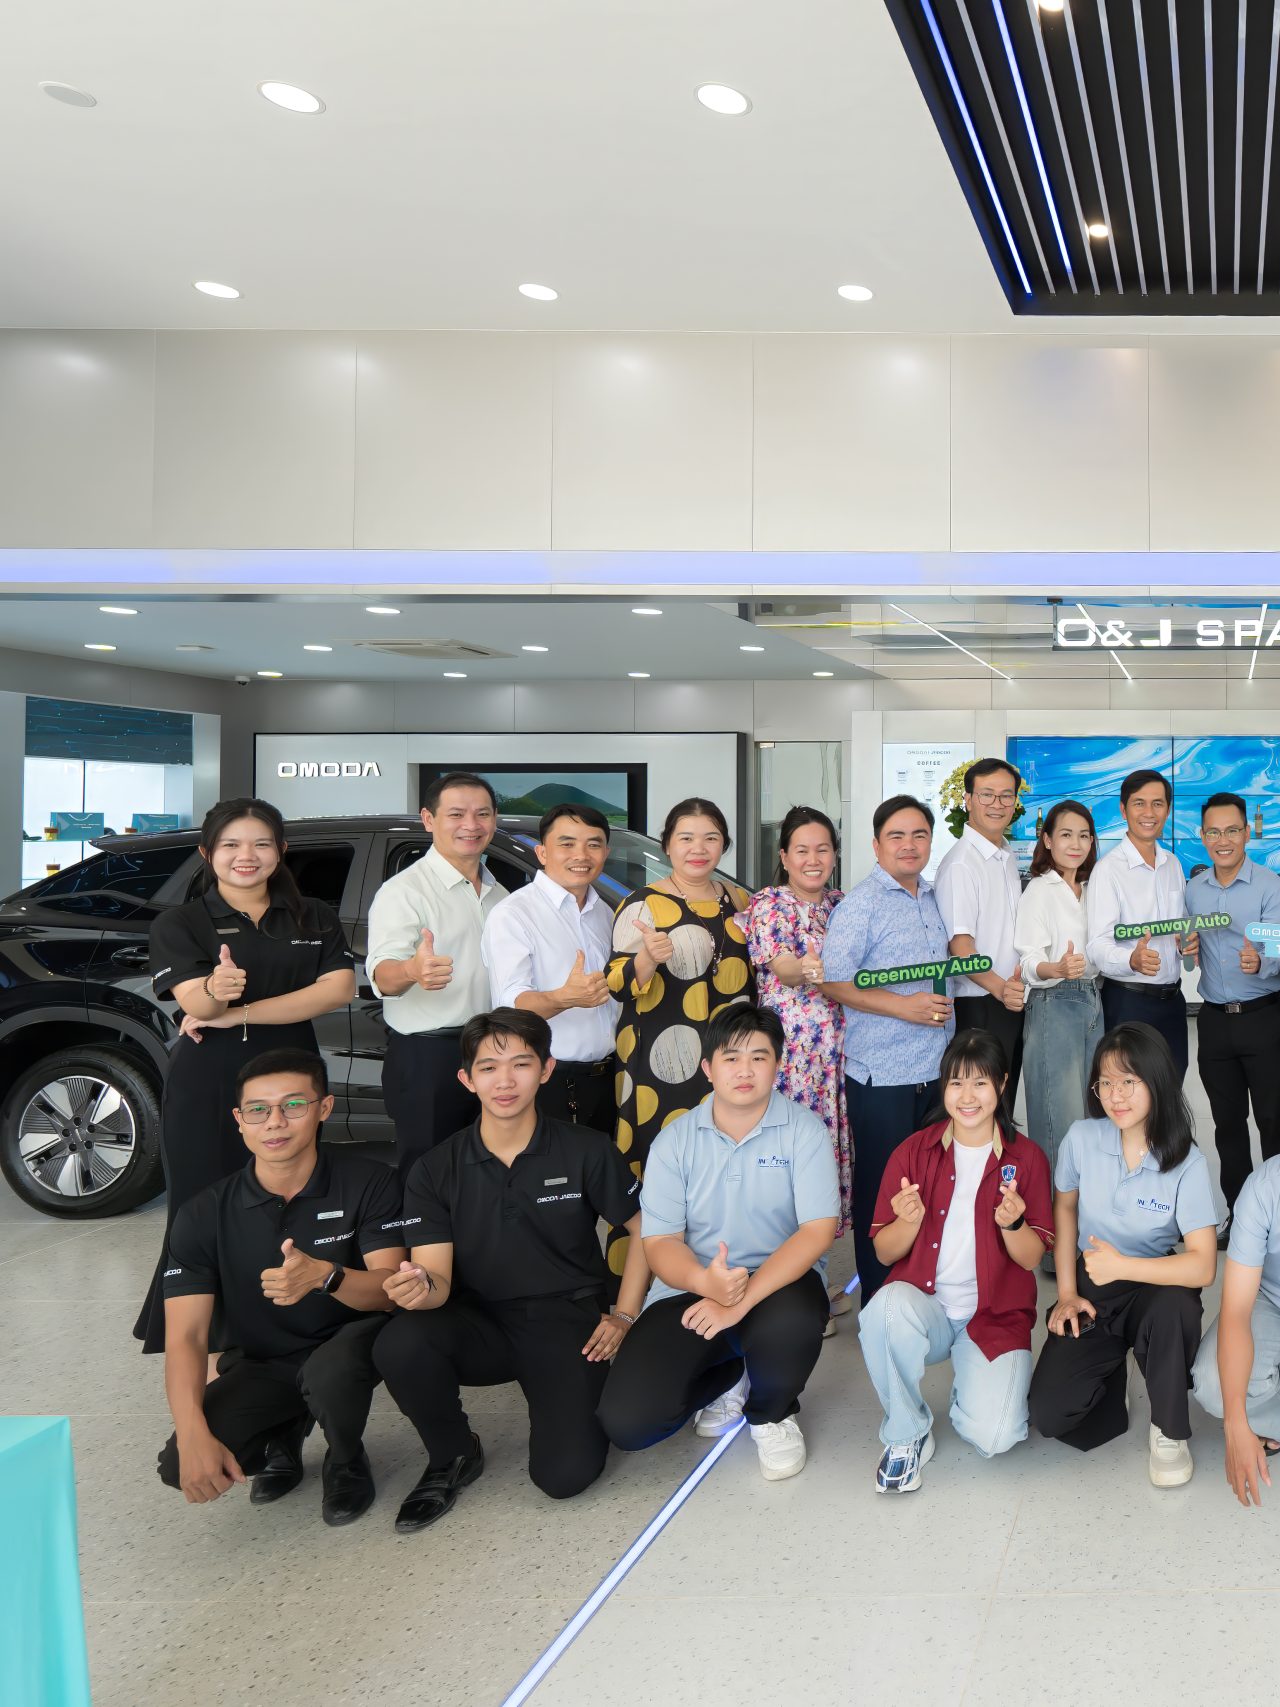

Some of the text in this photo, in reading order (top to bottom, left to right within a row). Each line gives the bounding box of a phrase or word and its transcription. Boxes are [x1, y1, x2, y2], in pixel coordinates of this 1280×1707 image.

[1057, 618, 1172, 647] O&J
[277, 761, 381, 778] OMODA
[1115, 914, 1230, 938] Greenway Auto
[857, 957, 991, 987] Greenway Auto
